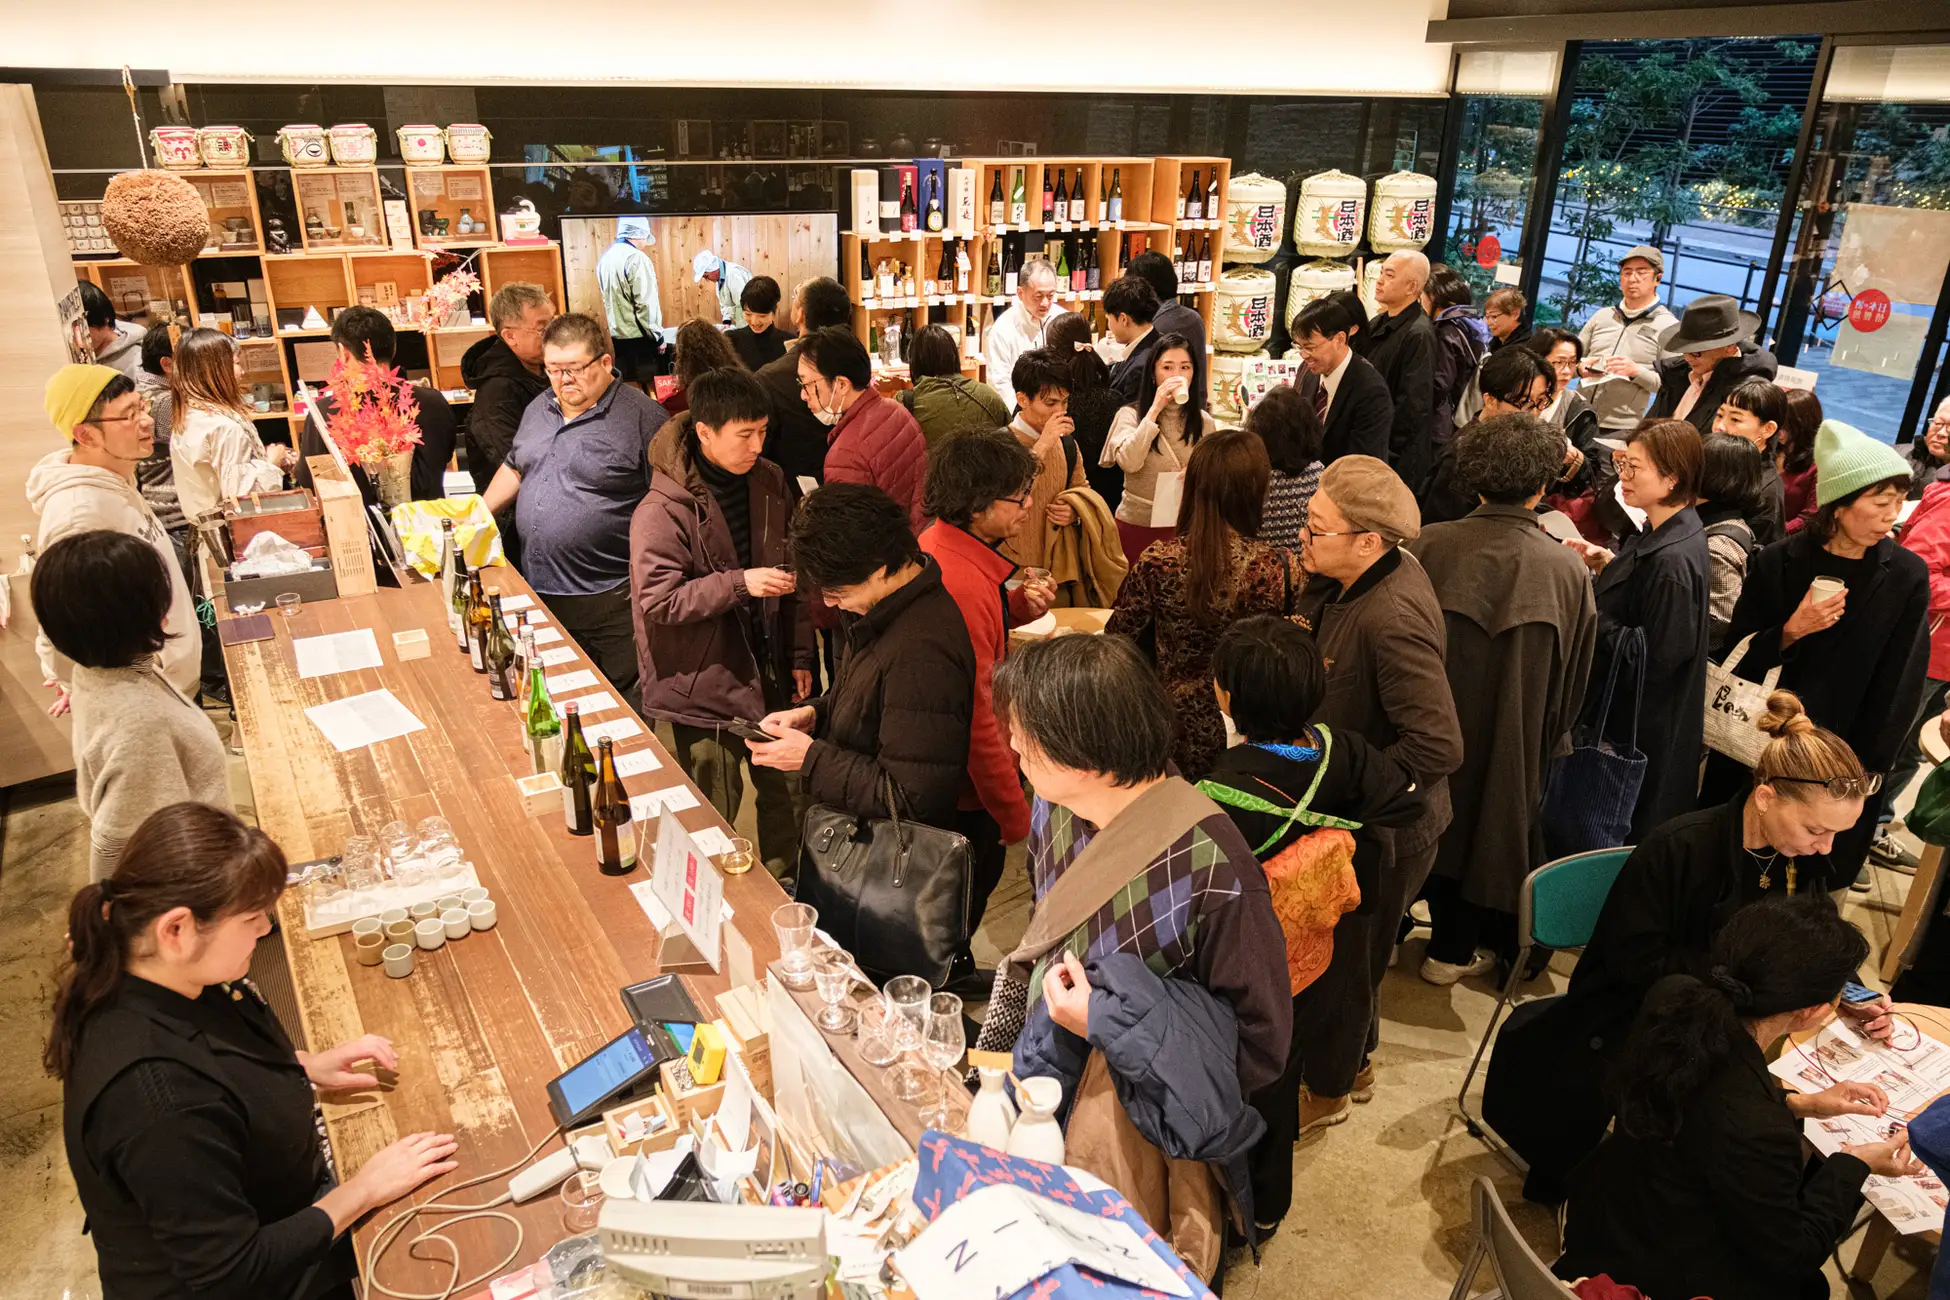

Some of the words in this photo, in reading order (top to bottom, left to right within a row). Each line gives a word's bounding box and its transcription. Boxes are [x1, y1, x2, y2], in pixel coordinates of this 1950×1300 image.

[1254, 205, 1275, 248] 日本酒
[1338, 200, 1357, 242] 日本酒
[1410, 199, 1430, 240] 日本酒
[1249, 296, 1267, 338] 日本酒
